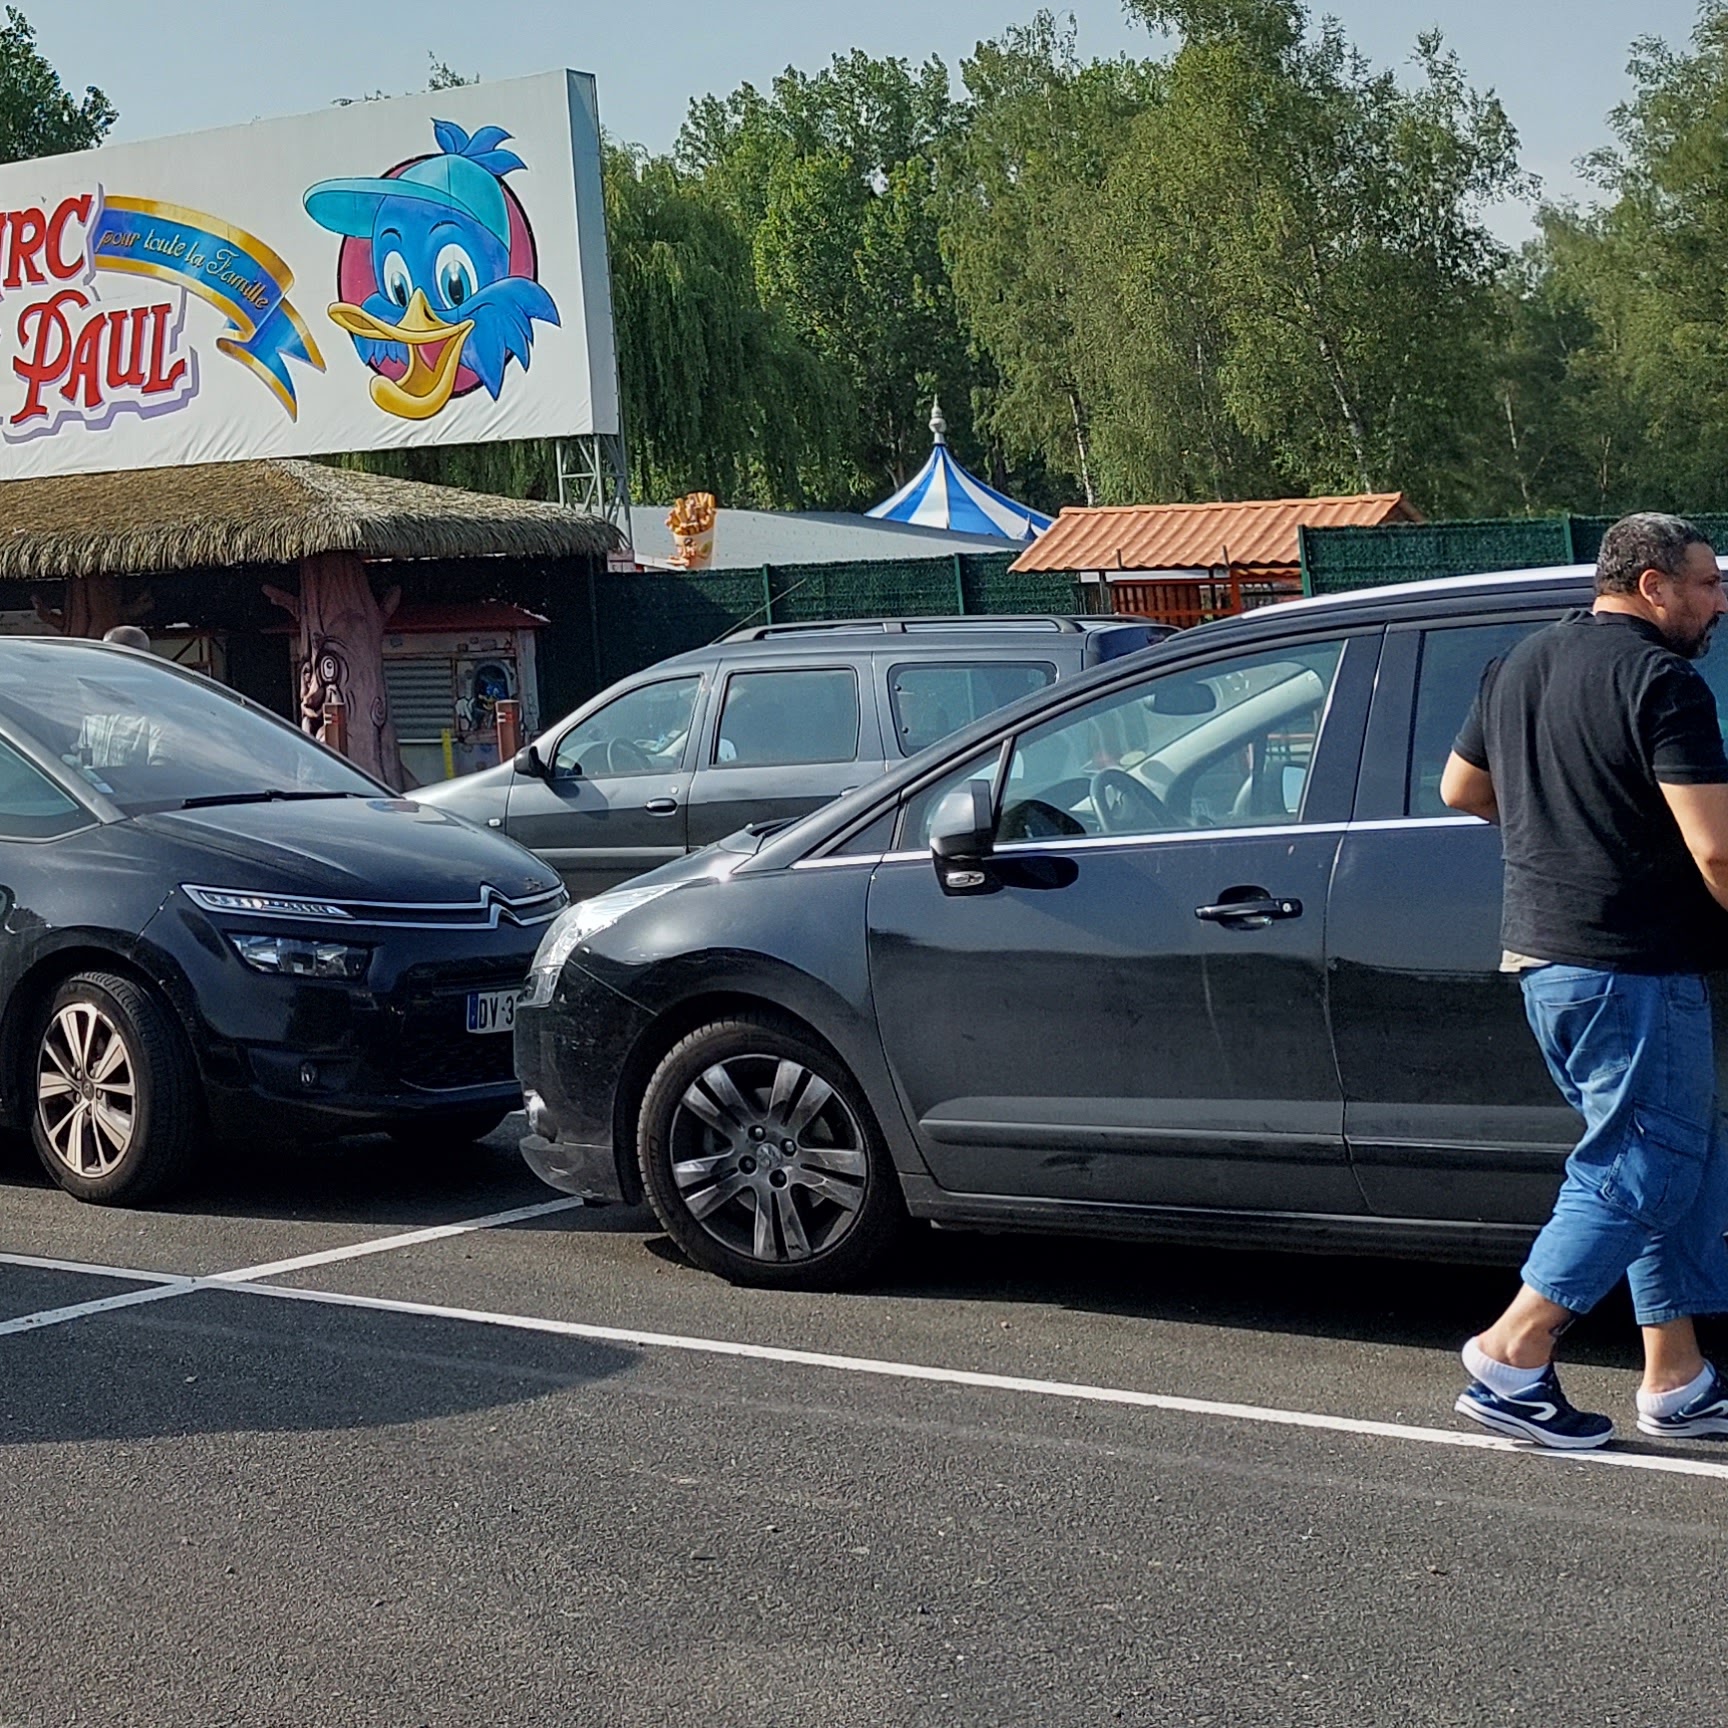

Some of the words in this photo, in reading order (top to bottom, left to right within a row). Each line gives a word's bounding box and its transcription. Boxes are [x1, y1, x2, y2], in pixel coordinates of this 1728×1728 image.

[94, 229, 141, 254] pour
[143, 228, 187, 258] toute
[185, 240, 207, 269] la
[205, 247, 270, 311] Famille
[8, 288, 189, 425] PAUL
[478, 994, 521, 1029] DV-3
